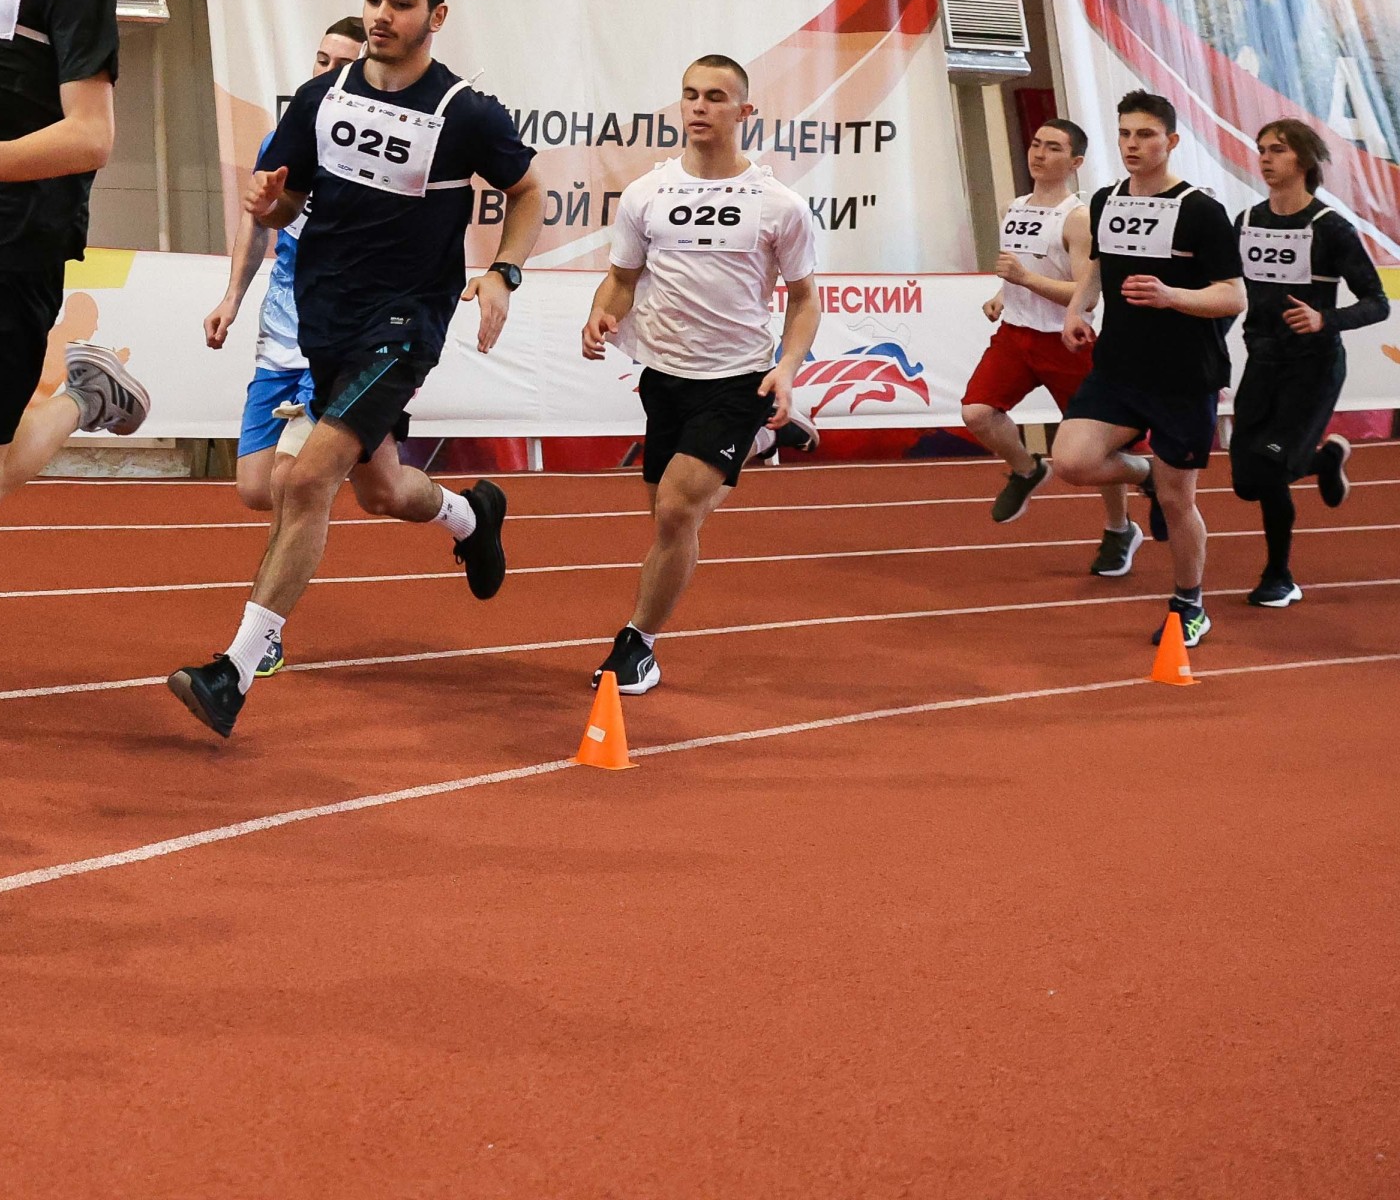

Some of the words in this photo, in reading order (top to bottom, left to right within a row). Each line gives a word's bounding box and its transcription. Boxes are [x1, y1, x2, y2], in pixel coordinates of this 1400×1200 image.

[330, 120, 412, 165] 025
[774, 119, 897, 161] ЦЕНТР
[668, 205, 742, 227] 026
[1108, 216, 1159, 236] 027
[1004, 220, 1043, 236] 032
[1247, 247, 1297, 266] 029
